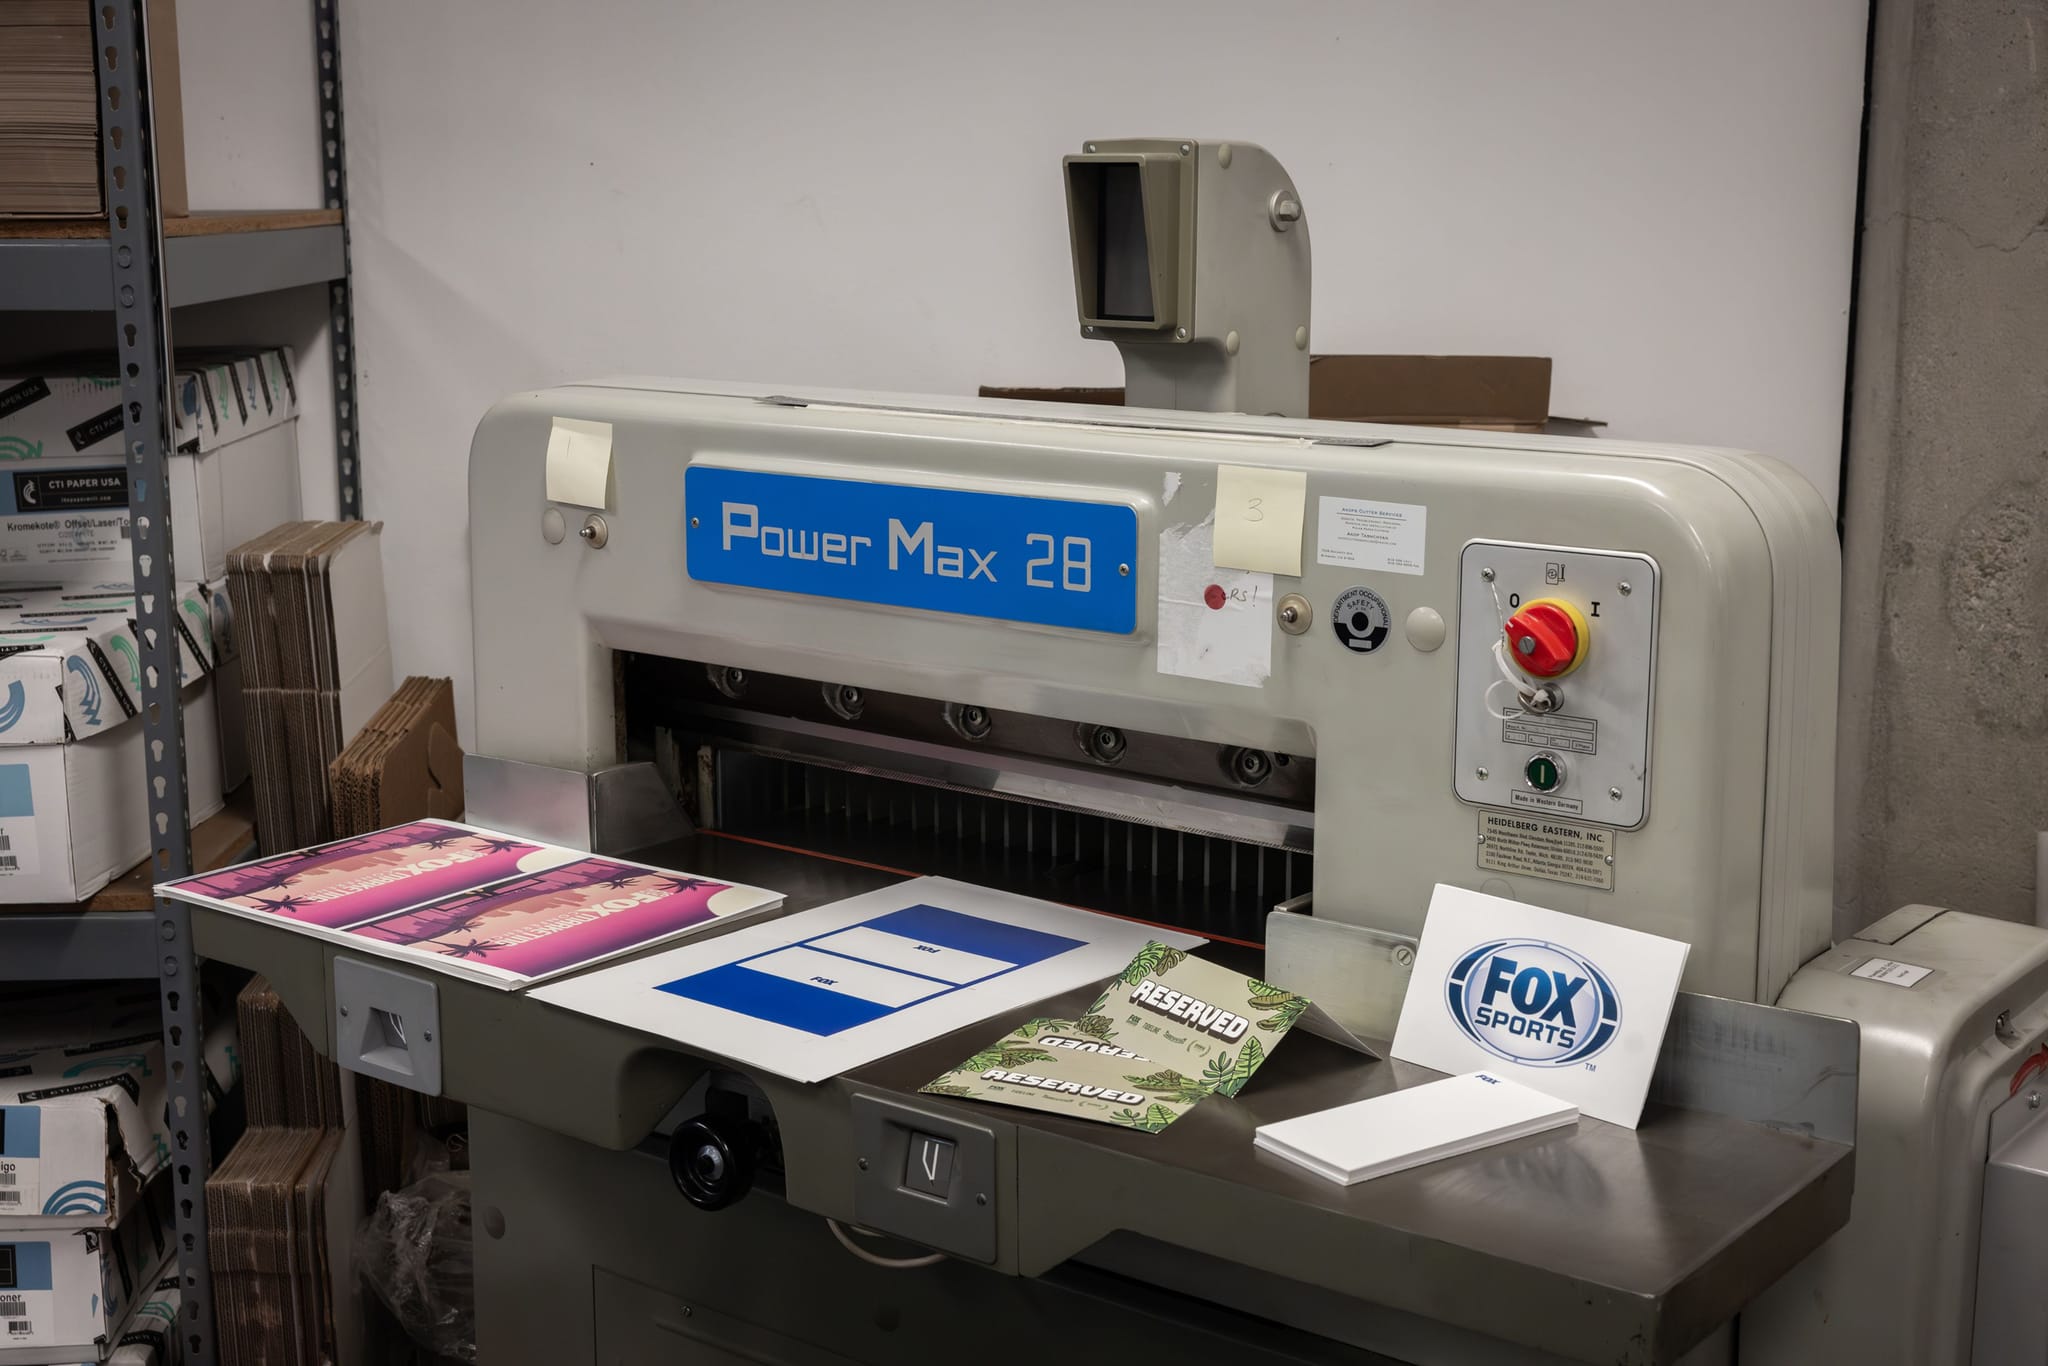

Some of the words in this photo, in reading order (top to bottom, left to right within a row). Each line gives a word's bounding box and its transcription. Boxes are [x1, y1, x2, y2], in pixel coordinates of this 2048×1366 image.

[48, 480, 65, 489] CTI
[66, 478, 98, 488] PAPER
[101, 477, 121, 487] USA
[1246, 498, 1265, 522] 3
[722, 501, 872, 566] Power
[888, 518, 998, 583] Max
[1026, 533, 1092, 593] 28
[1347, 599, 1375, 611] SAFETY
[1515, 794, 1528, 803] Made
[1536, 797, 1556, 806] Western
[1557, 800, 1579, 810] Germany
[1487, 816, 1538, 832] HEIDELBERG
[1542, 825, 1583, 841] EASTERN,
[1586, 831, 1605, 843] INC.
[391, 851, 476, 876] FOX
[576, 891, 660, 917] FOX
[494, 913, 597, 947] MARKETING
[913, 944, 942, 955] FOX
[809, 975, 840, 987] FOX
[1479, 955, 1589, 1029] FOX
[1129, 979, 1250, 1042] RESERVED
[1474, 1005, 1577, 1050] SPORTS
[1473, 1073, 1503, 1086] FOX
[1584, 1062, 1597, 1073] TM
[72, 1079, 113, 1092] PAPER
[980, 1068, 1146, 1106] RESERVED
